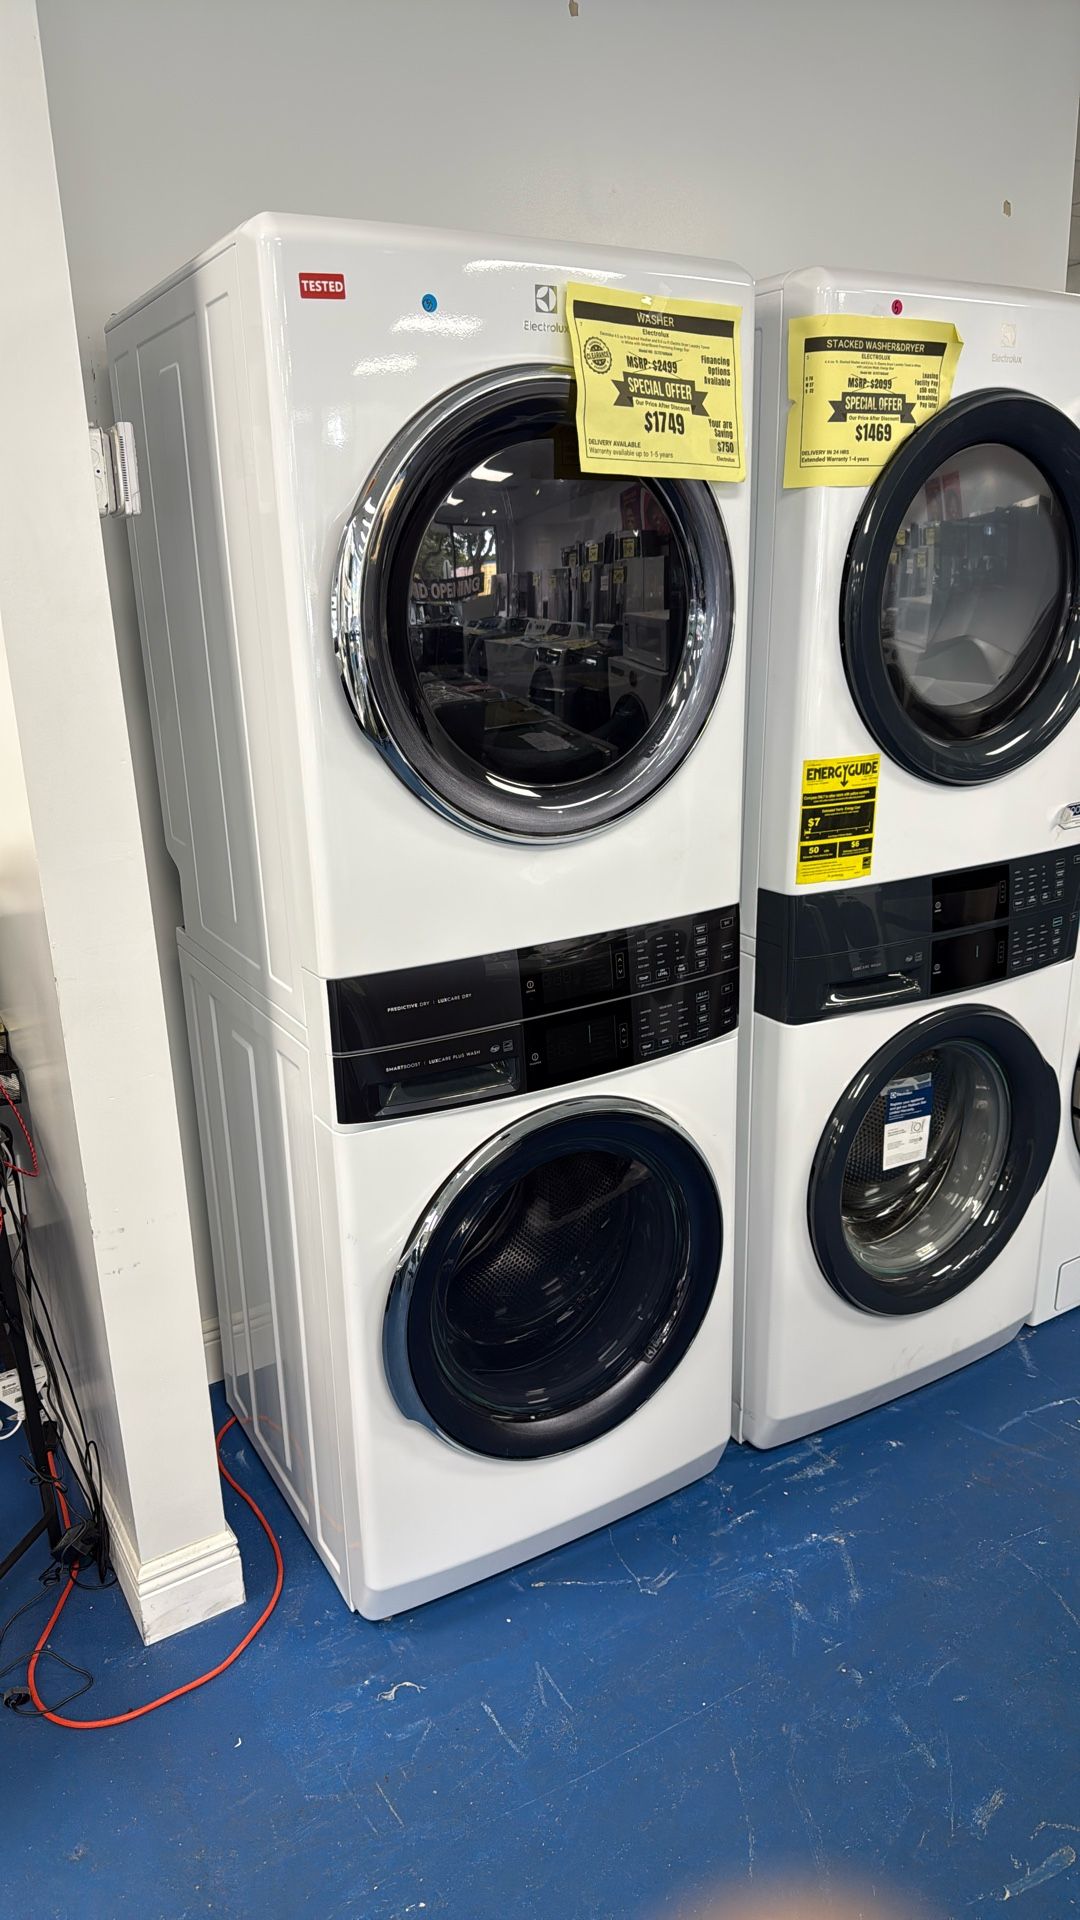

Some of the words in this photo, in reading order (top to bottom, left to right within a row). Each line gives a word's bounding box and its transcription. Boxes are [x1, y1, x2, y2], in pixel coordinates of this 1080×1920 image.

[301, 280, 344, 293] TESTED
[636, 312, 674, 328] WASHER
[642, 330, 669, 338] Electrolux
[826, 339, 864, 350] STACKED
[865, 340, 925, 353] WASHER&DRYER
[701, 355, 730, 367] Financing
[992, 353, 1022, 364] Electrolux
[652, 360, 678, 374] $2499
[708, 366, 730, 376] Options
[704, 376, 730, 387] Available
[870, 378, 892, 390] $2099
[628, 377, 664, 396] SPECIAL
[665, 382, 692, 400] OFFER
[671, 404, 690, 412] Discount
[845, 396, 877, 410] SPECIAL
[878, 398, 902, 411] OFFER
[644, 411, 685, 435] $1749
[708, 419, 721, 428] Your
[714, 428, 733, 439] Saving
[855, 424, 892, 442] $1469
[588, 438, 612, 447] DELIVERY
[613, 440, 641, 448] AVAILABLE
[717, 441, 734, 454] $750
[589, 447, 611, 456] Warranty
[612, 448, 634, 457] available
[806, 761, 878, 781] ENERGYGUIDE
[808, 817, 820, 827] $7
[387, 1003, 418, 1013] PREDICTIVE
[437, 994, 461, 1004] LUXCARE
[386, 1061, 421, 1072] SMARTBOOST
[429, 1056, 452, 1065] LUXCARE
